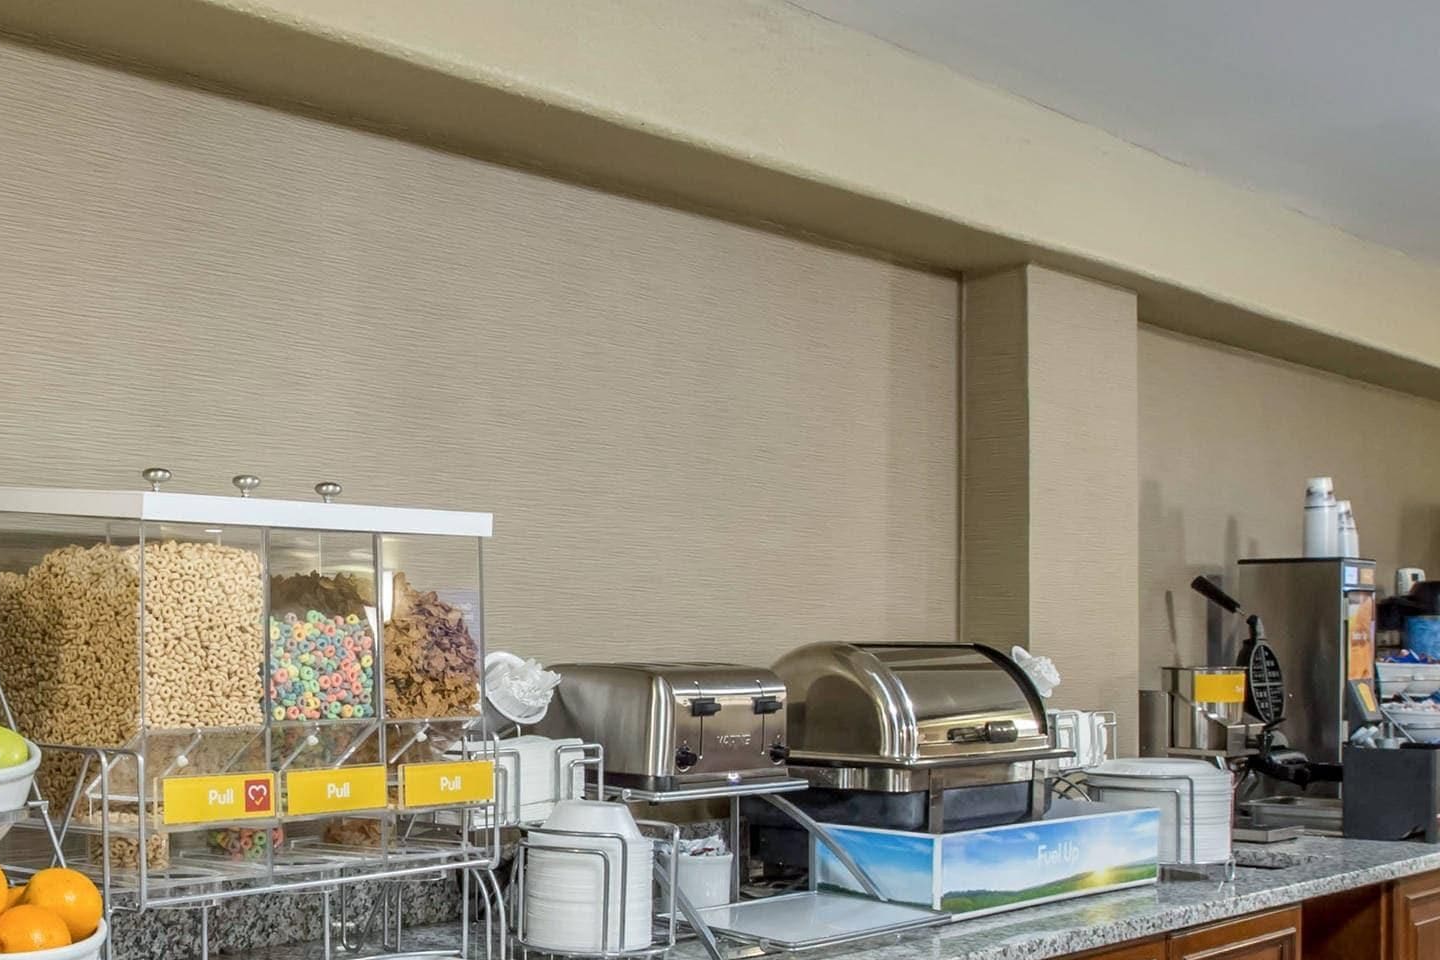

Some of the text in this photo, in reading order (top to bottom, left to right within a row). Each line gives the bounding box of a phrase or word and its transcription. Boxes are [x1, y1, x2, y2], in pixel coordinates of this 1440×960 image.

[327, 782, 350, 799] Pull
[440, 775, 462, 791] Pull
[208, 787, 234, 805] Pull
[1038, 840, 1080, 865] Fuel Up
